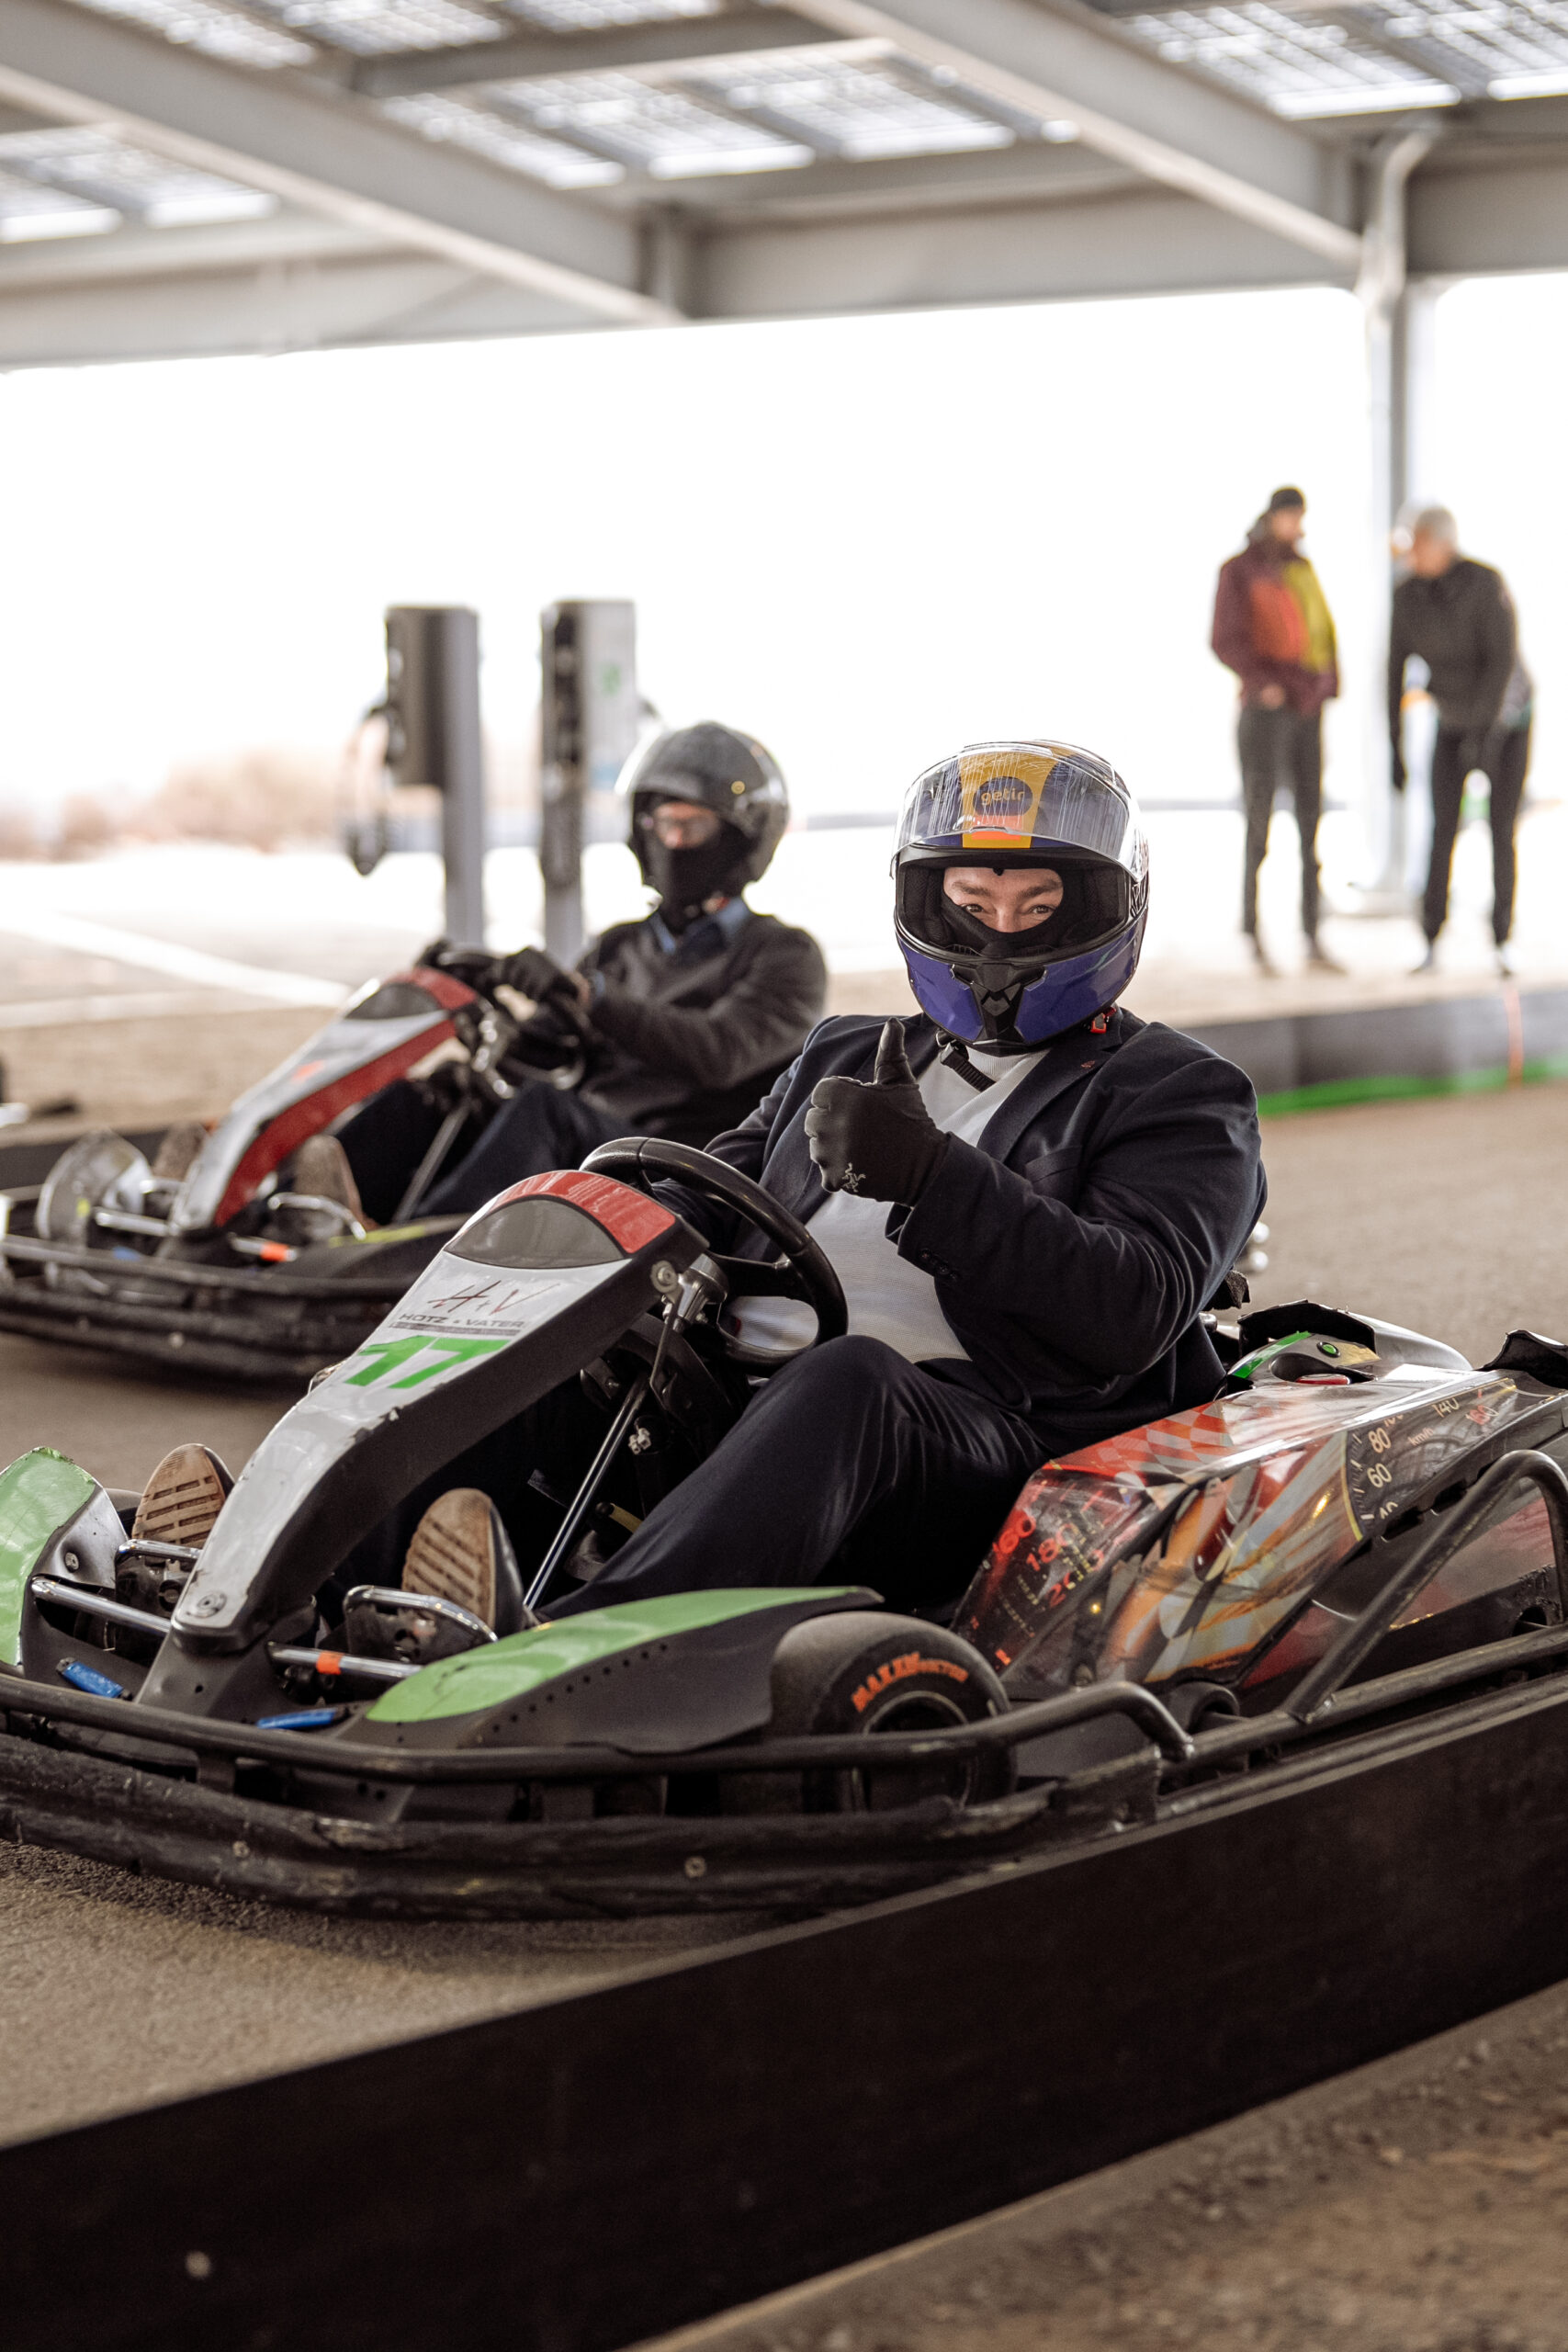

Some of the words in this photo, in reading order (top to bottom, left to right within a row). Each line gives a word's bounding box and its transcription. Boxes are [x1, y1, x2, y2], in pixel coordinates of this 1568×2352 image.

[981, 787, 1025, 806] getir
[399, 1313, 448, 1325] HOTZ
[465, 1317, 525, 1329] VATER
[342, 1334, 511, 1389] 17
[1368, 1427, 1392, 1453] 80
[1407, 1427, 1434, 1446] km/h
[1367, 1463, 1393, 1488] 60
